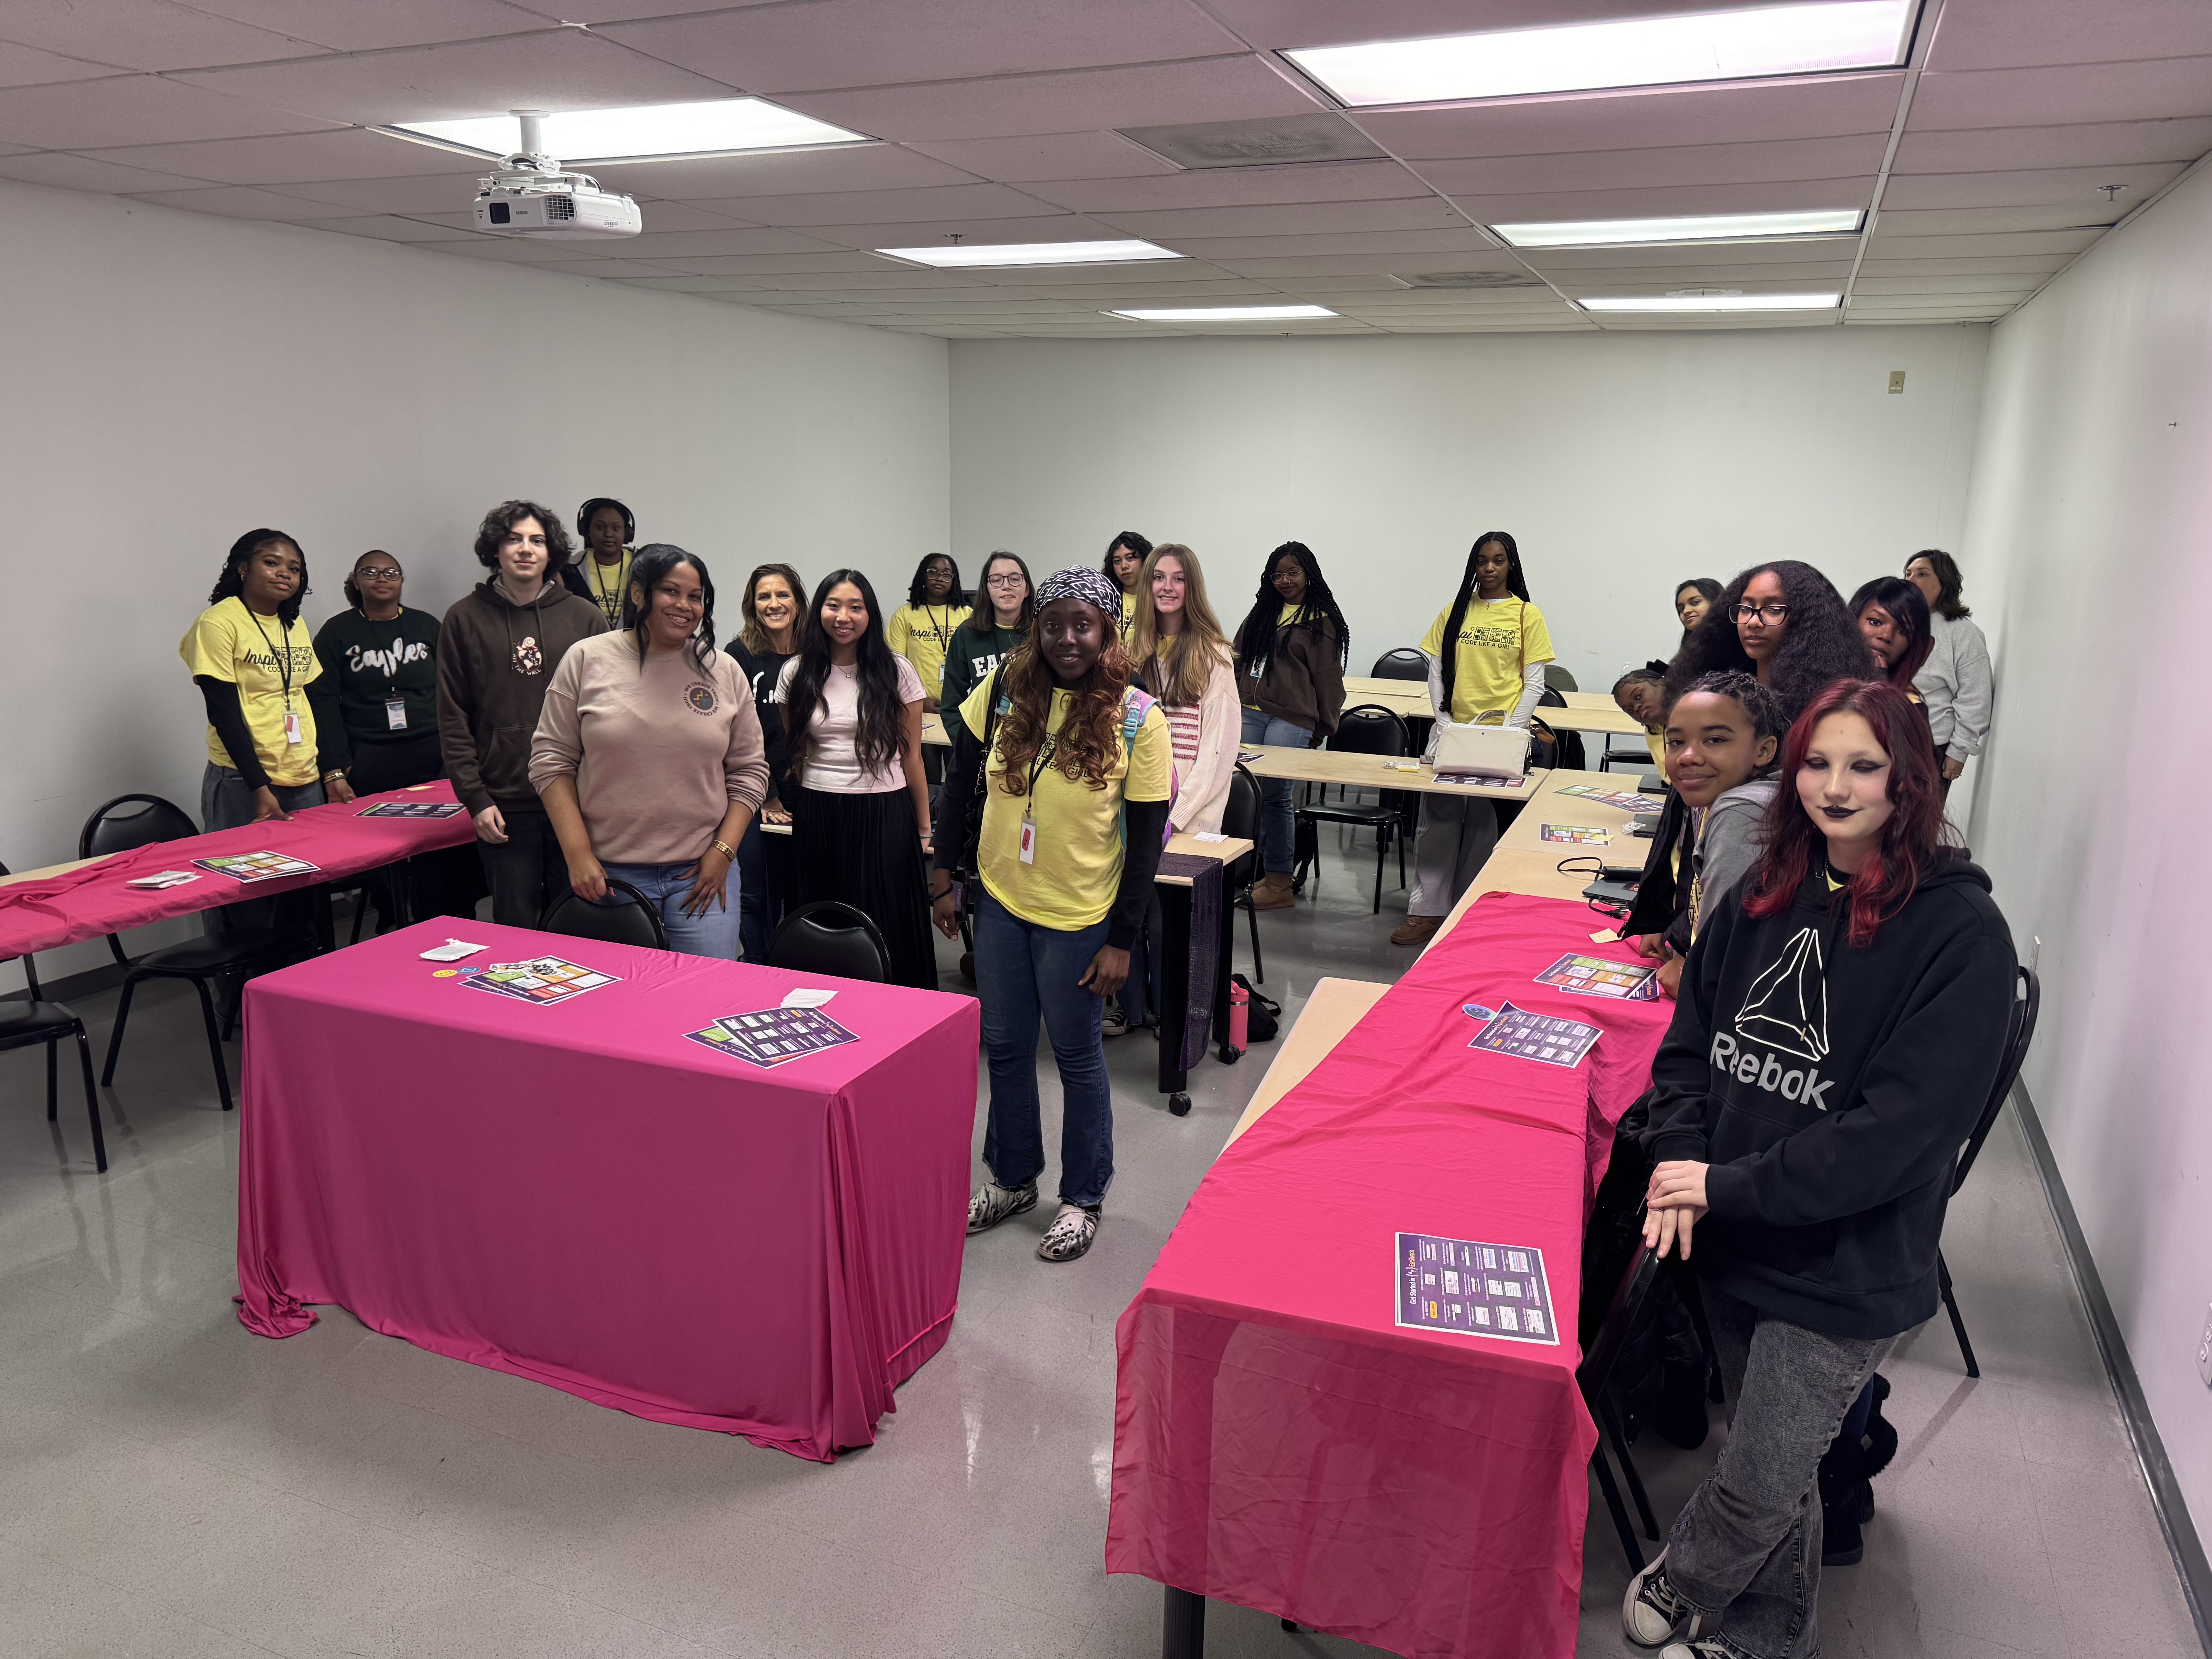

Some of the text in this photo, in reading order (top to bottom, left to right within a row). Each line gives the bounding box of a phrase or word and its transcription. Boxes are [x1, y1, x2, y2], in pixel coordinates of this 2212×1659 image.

[528, 650, 538, 666] VANS
[515, 665, 525, 673] THE
[684, 697, 692, 709] TECH
[1710, 1031, 1835, 1111] Reebok
